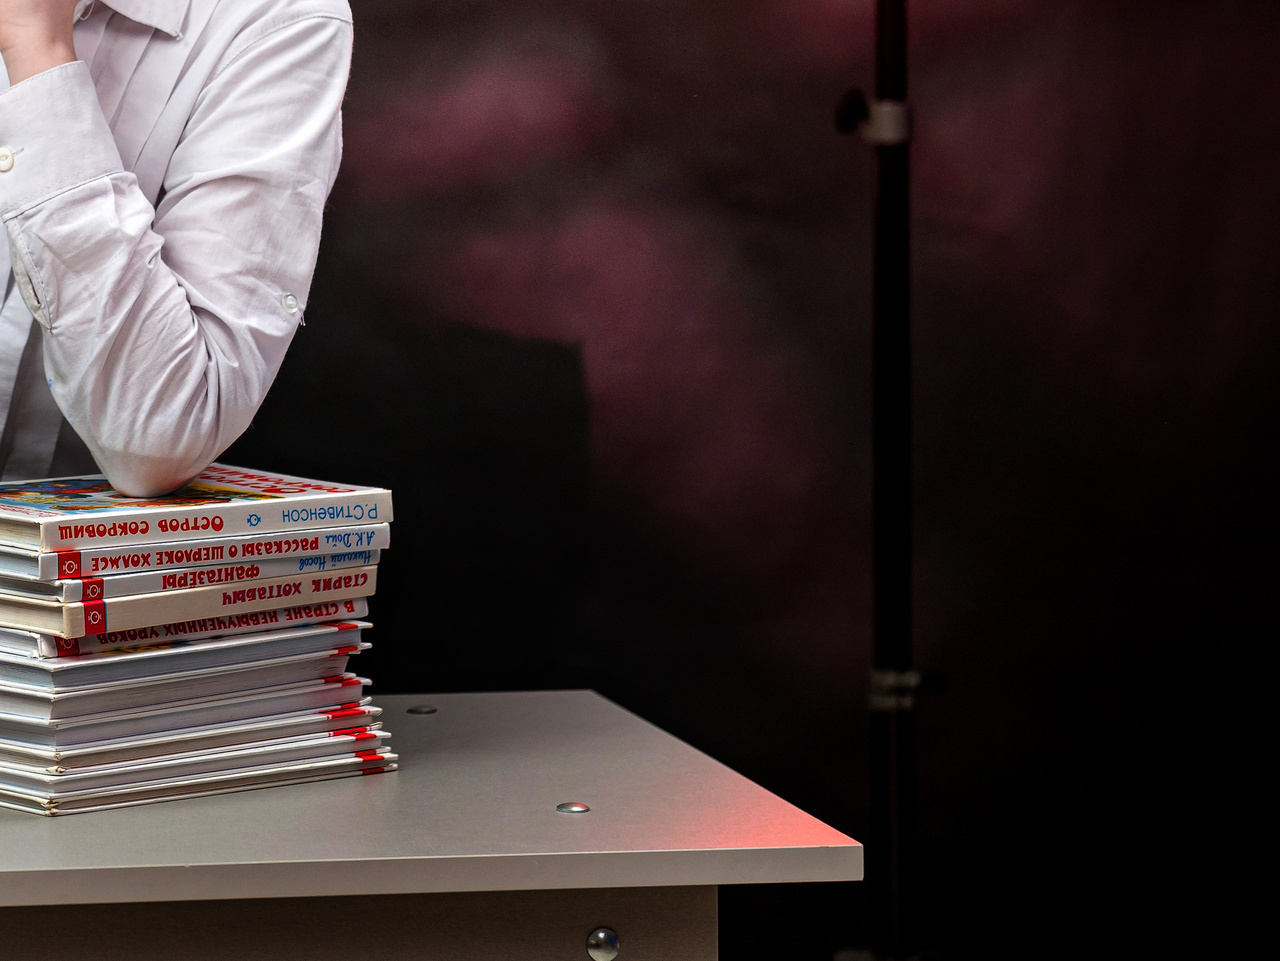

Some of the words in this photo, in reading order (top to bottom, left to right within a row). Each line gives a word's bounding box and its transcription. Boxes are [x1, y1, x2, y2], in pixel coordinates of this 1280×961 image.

[156, 545, 224, 565] ШЕРЛОКЕ
[229, 544, 238, 557] О
[241, 537, 319, 557] РАССКАЗЫ
[91, 554, 151, 572] ХОЛМСЕ
[299, 556, 326, 571] Носов
[331, 550, 371, 565] Николай
[161, 564, 259, 590] ФАНТАЗЁРЫ
[312, 572, 368, 592] СТАРИК
[222, 582, 302, 605] ХОТТАБЫЧ
[284, 603, 335, 621] СТРАНЕ
[344, 600, 355, 612] В
[162, 610, 279, 636] НЕВЫУЧЕННЫХ
